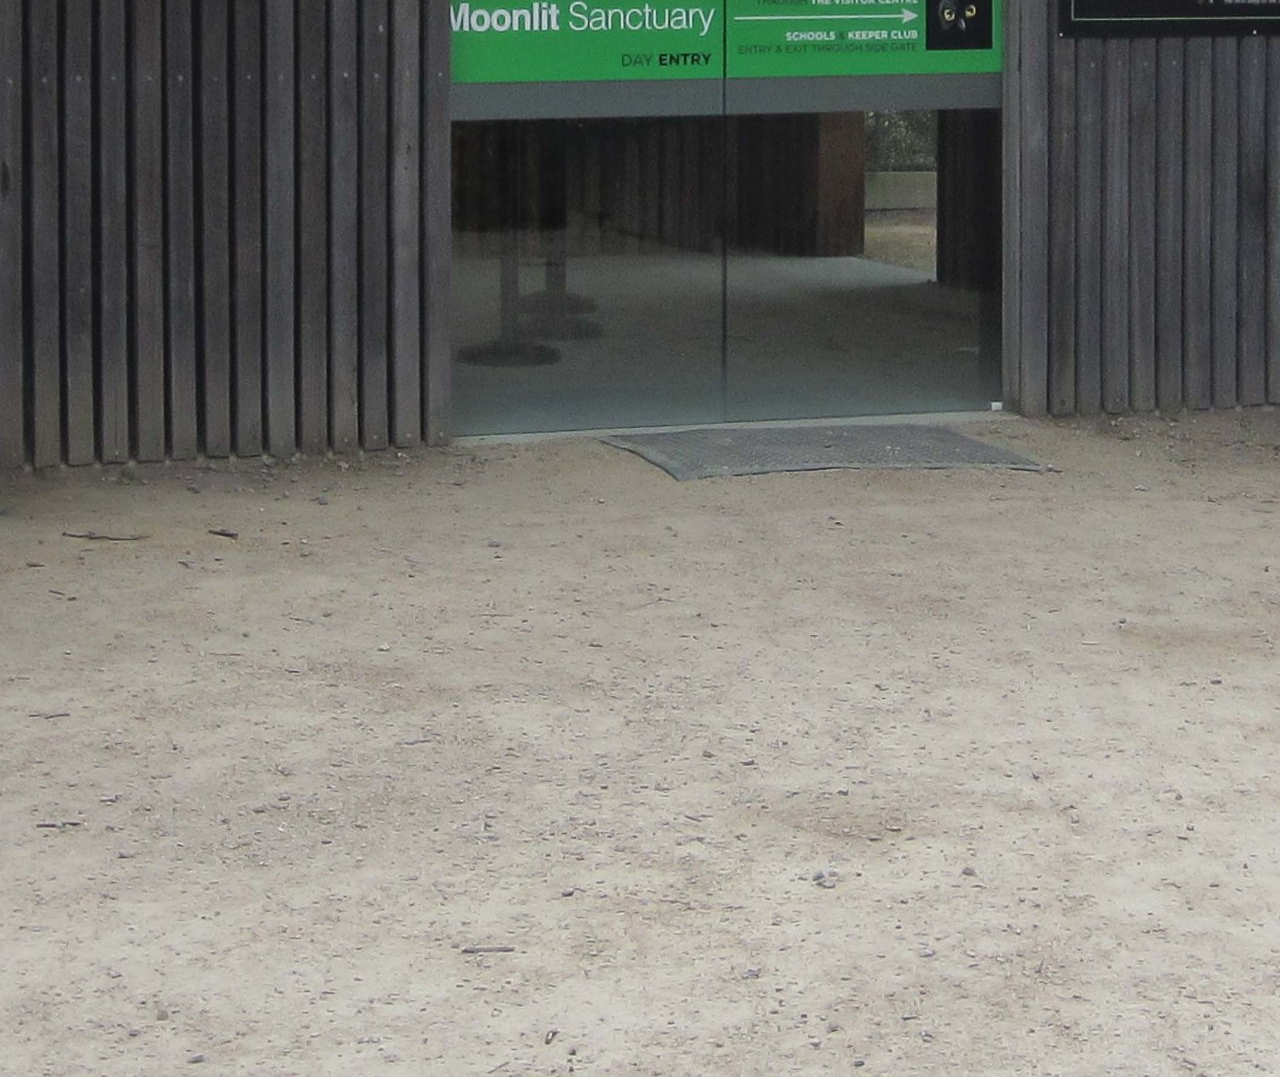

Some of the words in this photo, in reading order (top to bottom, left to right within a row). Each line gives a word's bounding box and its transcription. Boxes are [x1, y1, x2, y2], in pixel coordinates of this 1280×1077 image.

[569, 1, 716, 36] Sanctuary
[786, 31, 836, 41] SCHOOLS
[848, 30, 888, 40] KEEPER
[890, 30, 918, 39] CLUB
[737, 45, 774, 55] ENTRY
[891, 43, 917, 52] GATE
[621, 54, 652, 66] DAY
[659, 52, 712, 66] ENTRY
